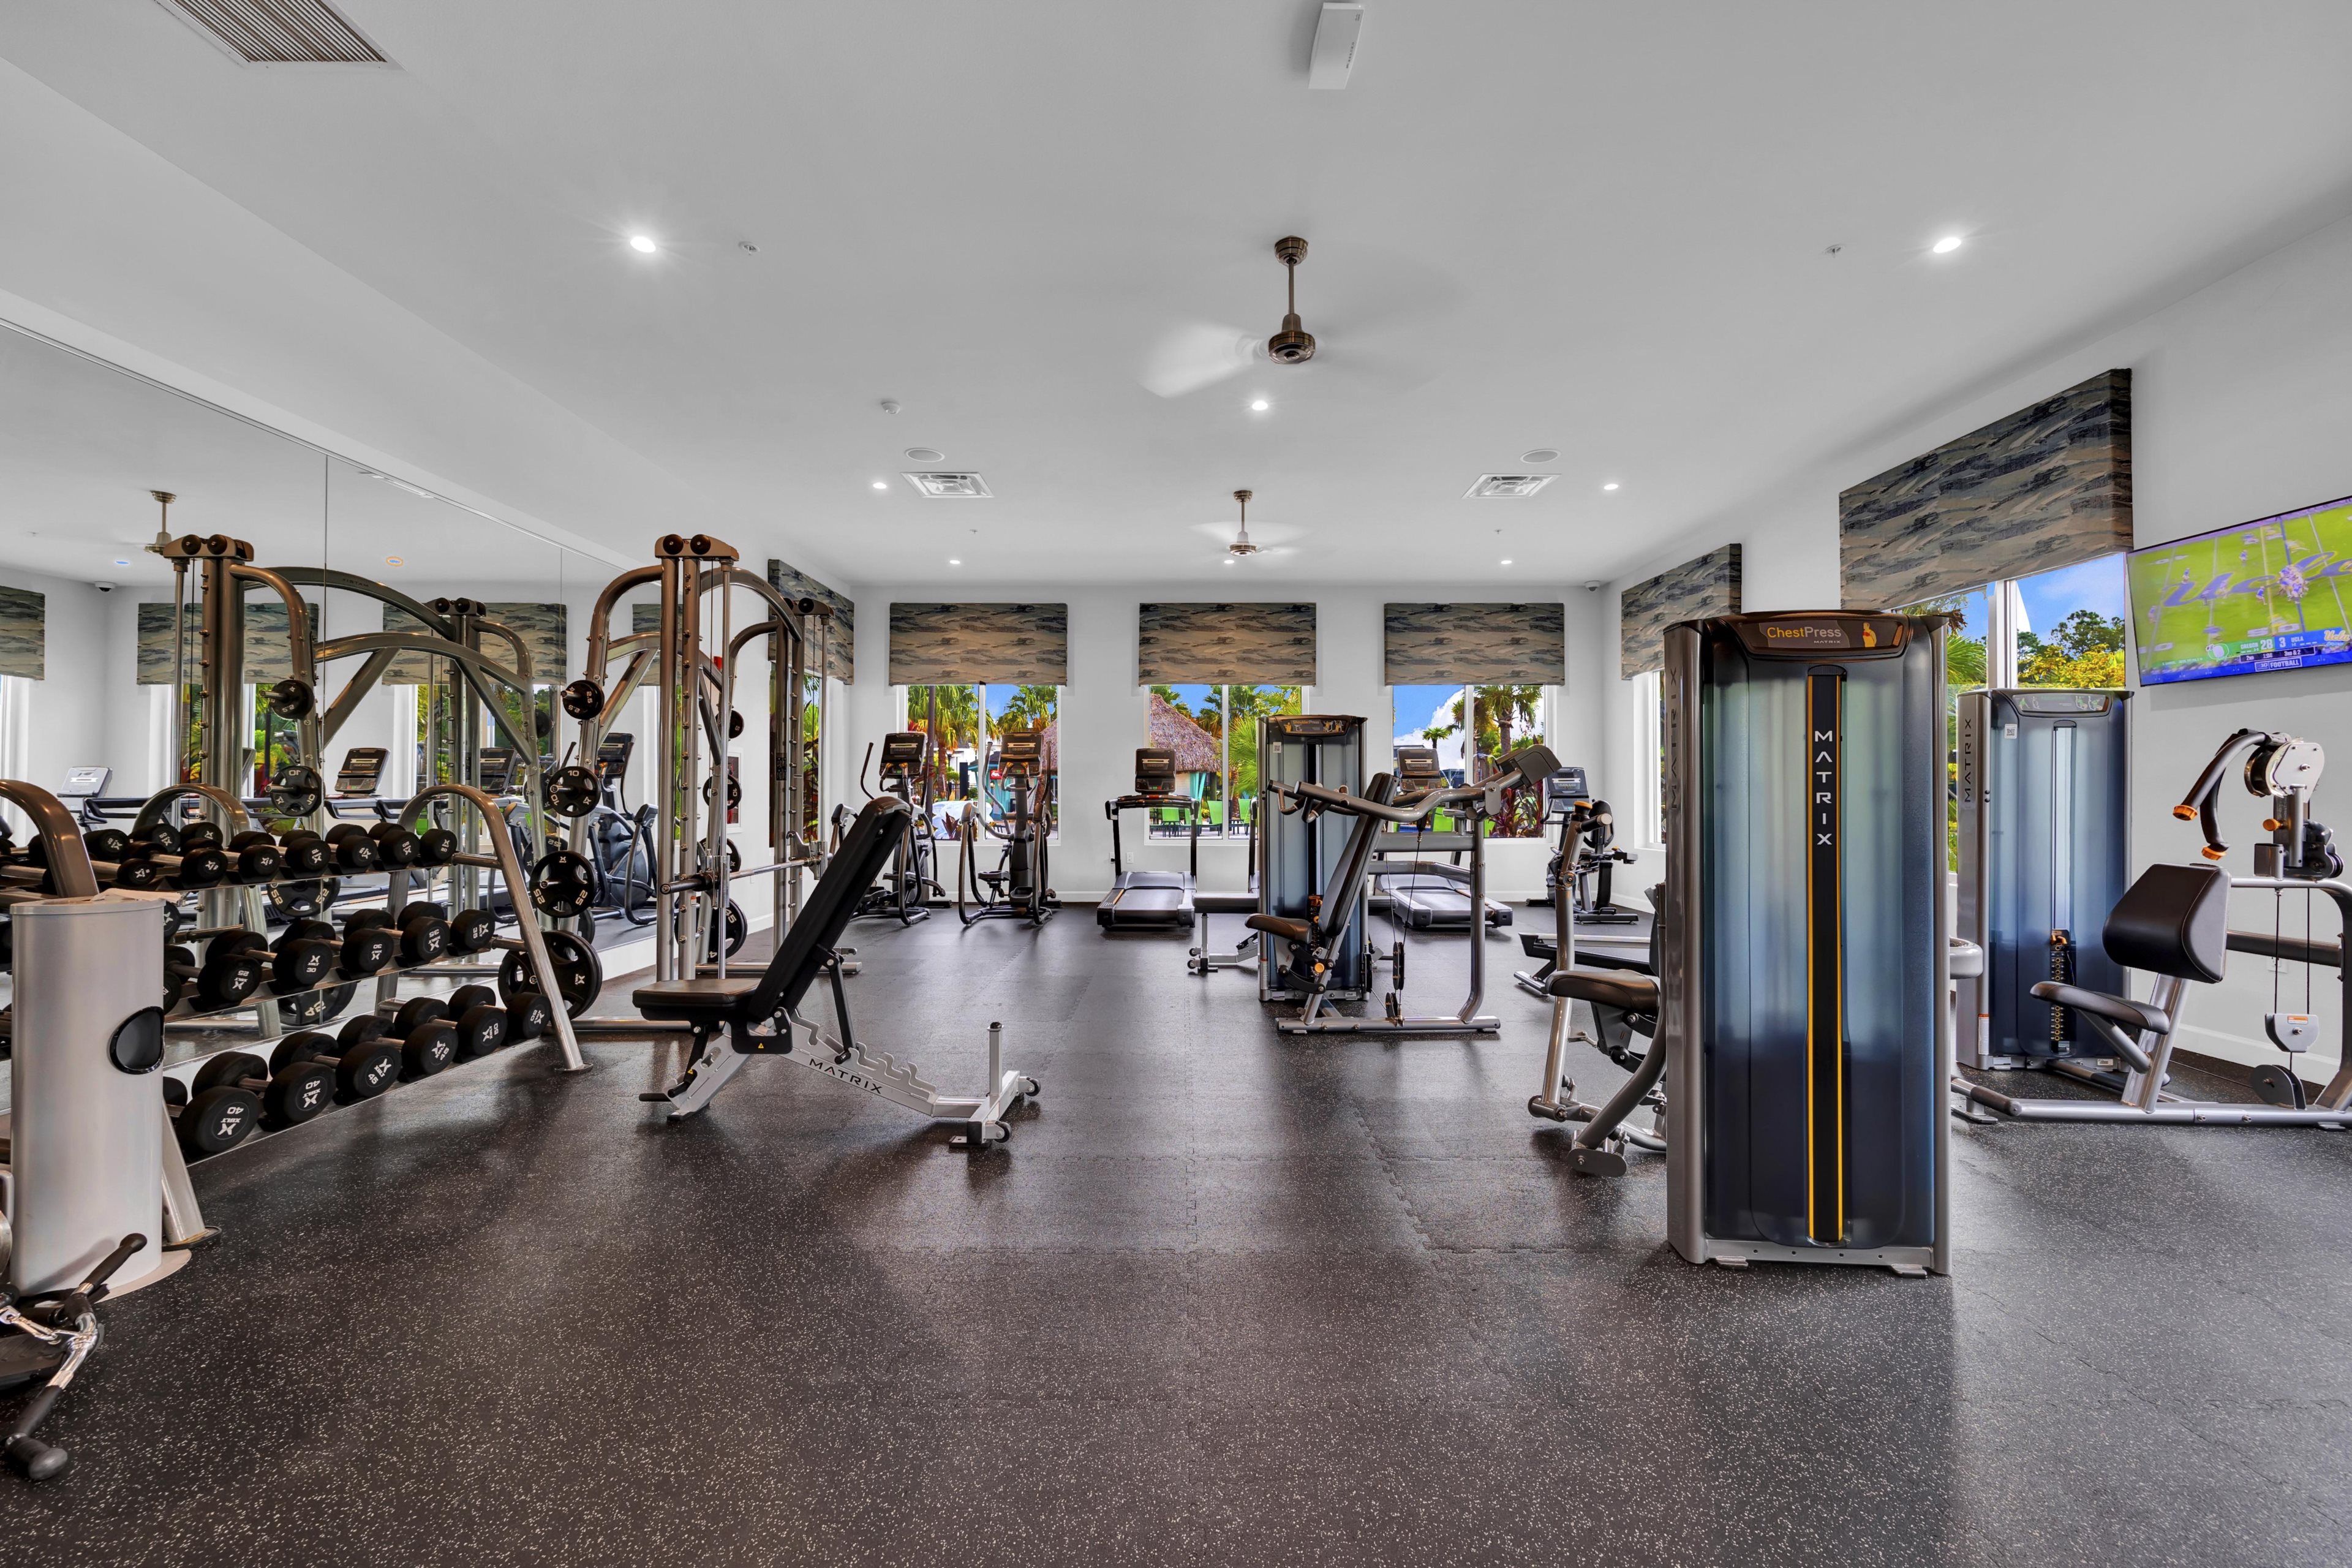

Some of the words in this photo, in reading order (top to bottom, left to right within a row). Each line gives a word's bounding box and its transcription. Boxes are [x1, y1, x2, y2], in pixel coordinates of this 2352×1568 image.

[1766, 626, 1841, 638] ChestPress
[2260, 639, 2274, 650] 28
[2278, 637, 2286, 647] 3
[2270, 659, 2299, 668] FOOTBALL
[1814, 730, 1833, 845] MATRIX
[551, 794, 560, 805] 10
[533, 888, 546, 904] 25
[576, 889, 588, 906] 25
[368, 1073, 379, 1084] 45
[809, 1058, 883, 1094] MATRIX
[306, 1080, 320, 1090] 40
[227, 1106, 244, 1115] 40
